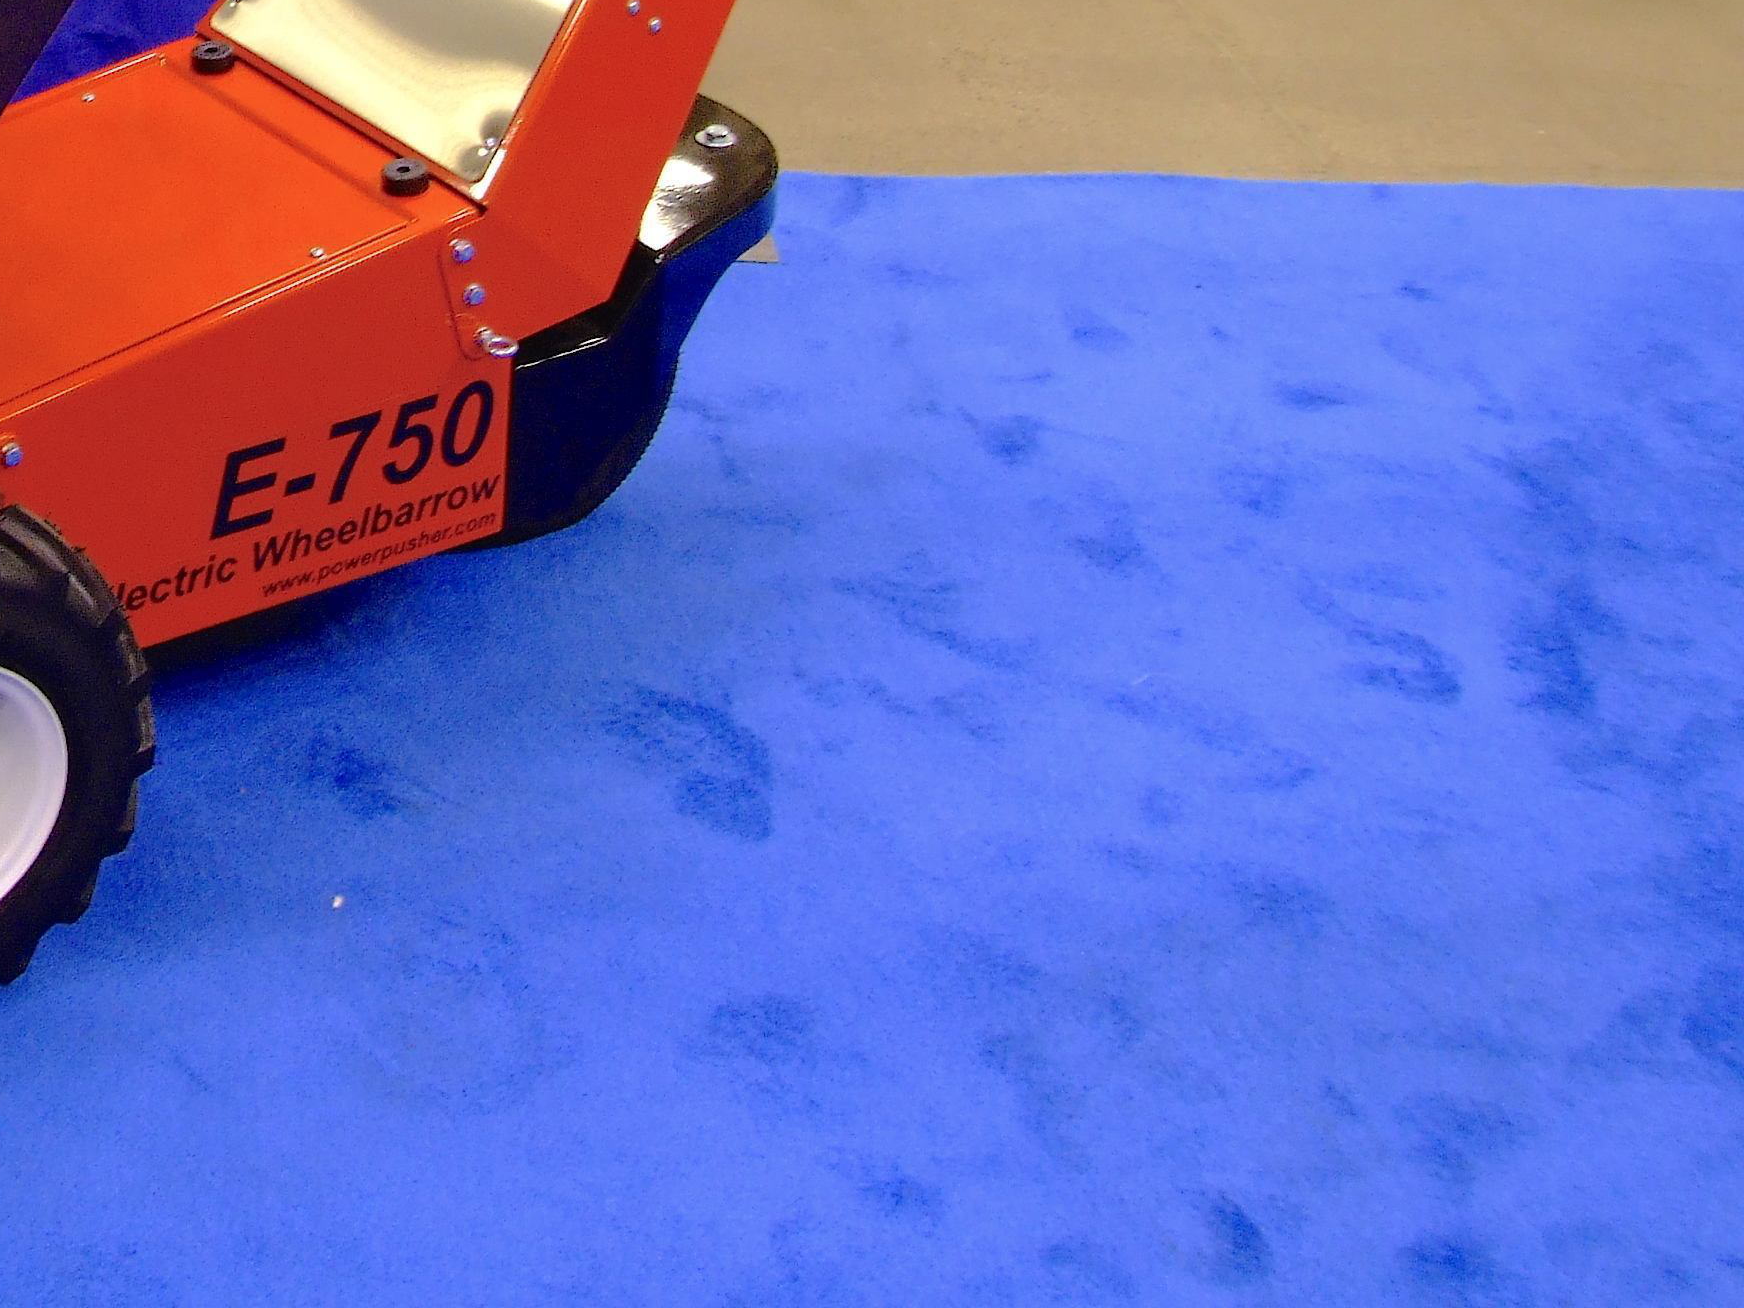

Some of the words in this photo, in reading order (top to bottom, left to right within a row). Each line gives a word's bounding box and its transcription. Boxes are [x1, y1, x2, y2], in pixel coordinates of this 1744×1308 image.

[209, 380, 495, 541] E-750
[113, 553, 239, 612] lectric
[253, 474, 502, 573] Wheelbarrow
[259, 512, 498, 598] www.powerpusher.com
